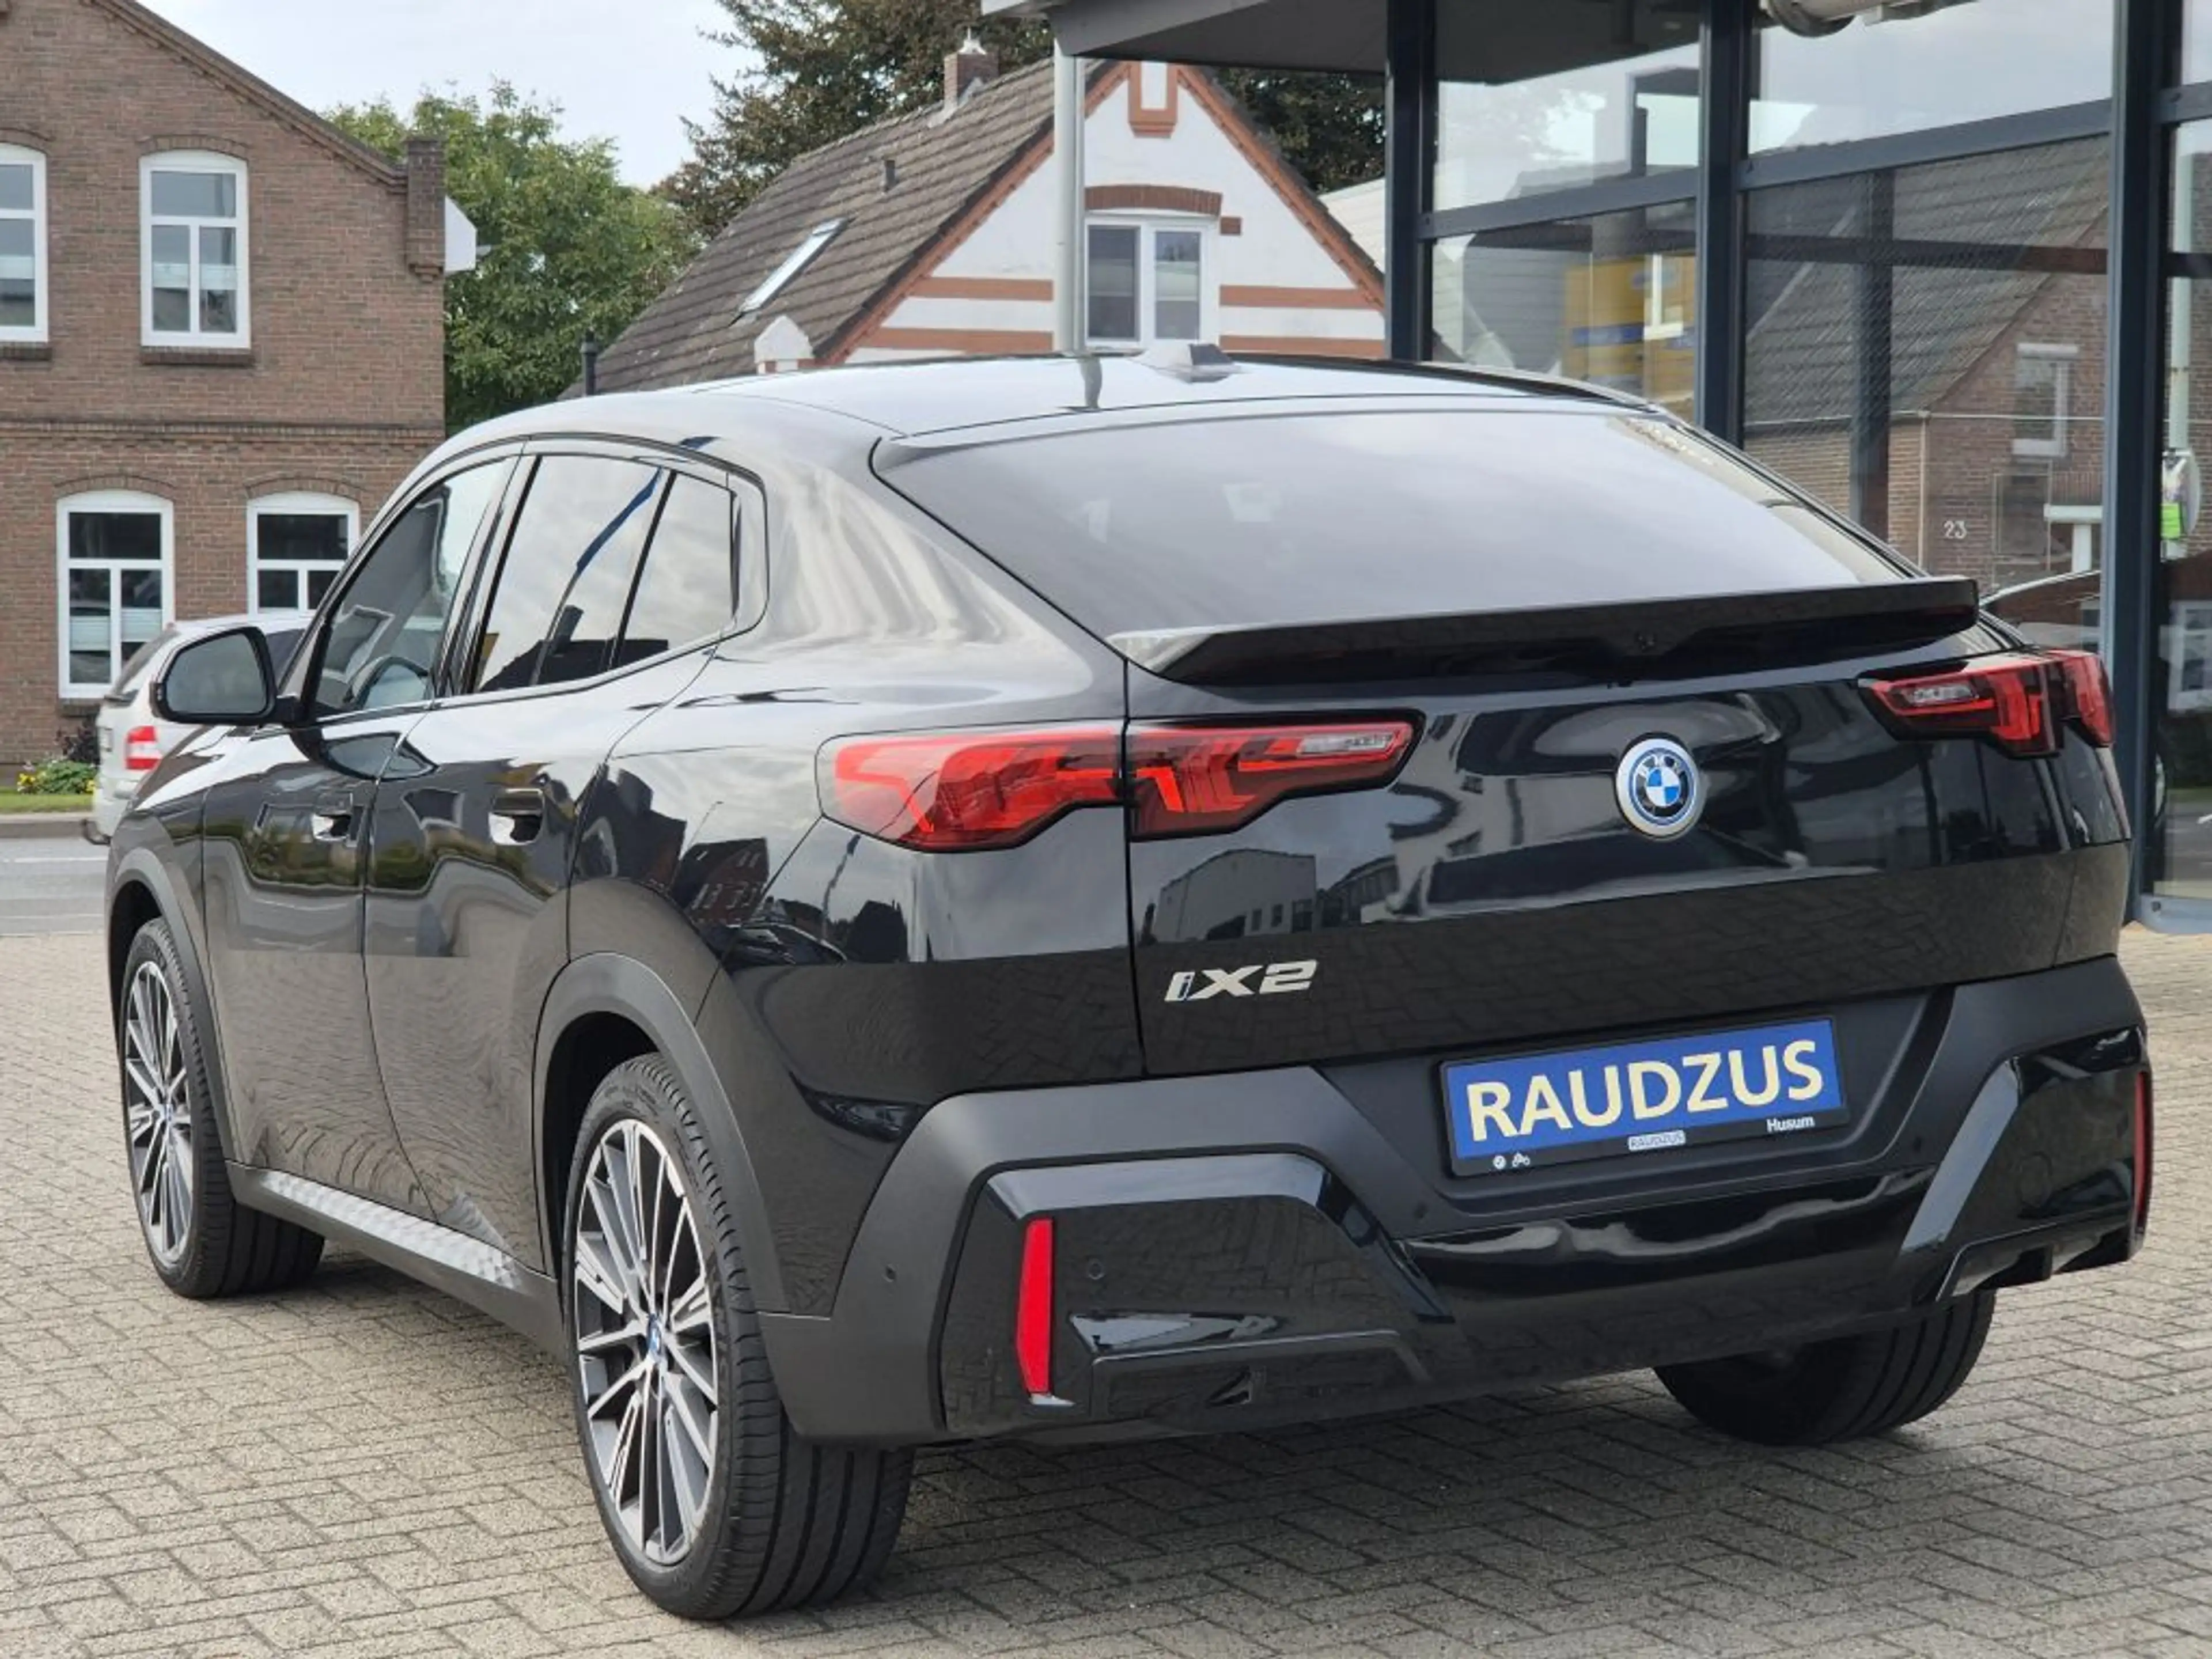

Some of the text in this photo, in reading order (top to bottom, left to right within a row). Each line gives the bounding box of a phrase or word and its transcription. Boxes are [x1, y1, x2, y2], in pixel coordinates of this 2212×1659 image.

[1944, 520, 1967, 539] 23
[1466, 1039, 1823, 1142] RAUDZUS
[1766, 1117, 1815, 1133] Husum
